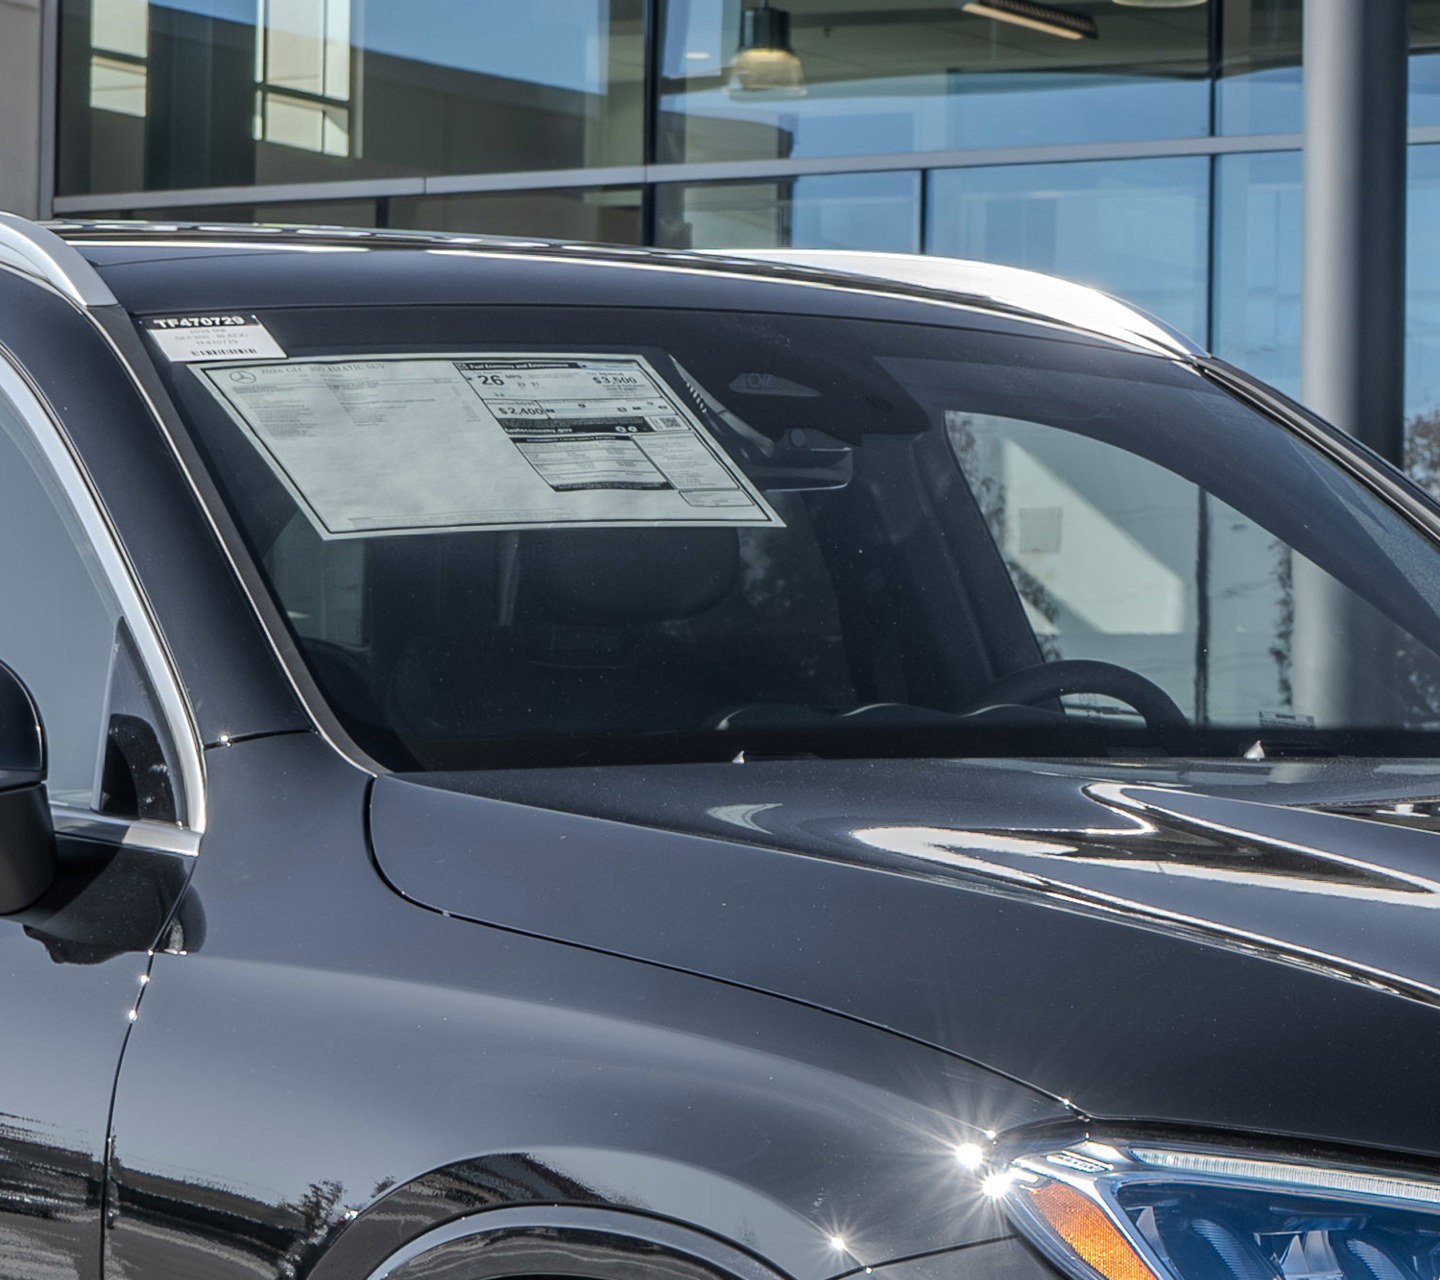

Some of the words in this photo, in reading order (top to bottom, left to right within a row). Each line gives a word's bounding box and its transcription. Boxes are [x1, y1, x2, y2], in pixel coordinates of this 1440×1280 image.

[478, 374, 505, 387] 26
[592, 376, 638, 387] $3,500
[498, 407, 544, 416] $2,400
